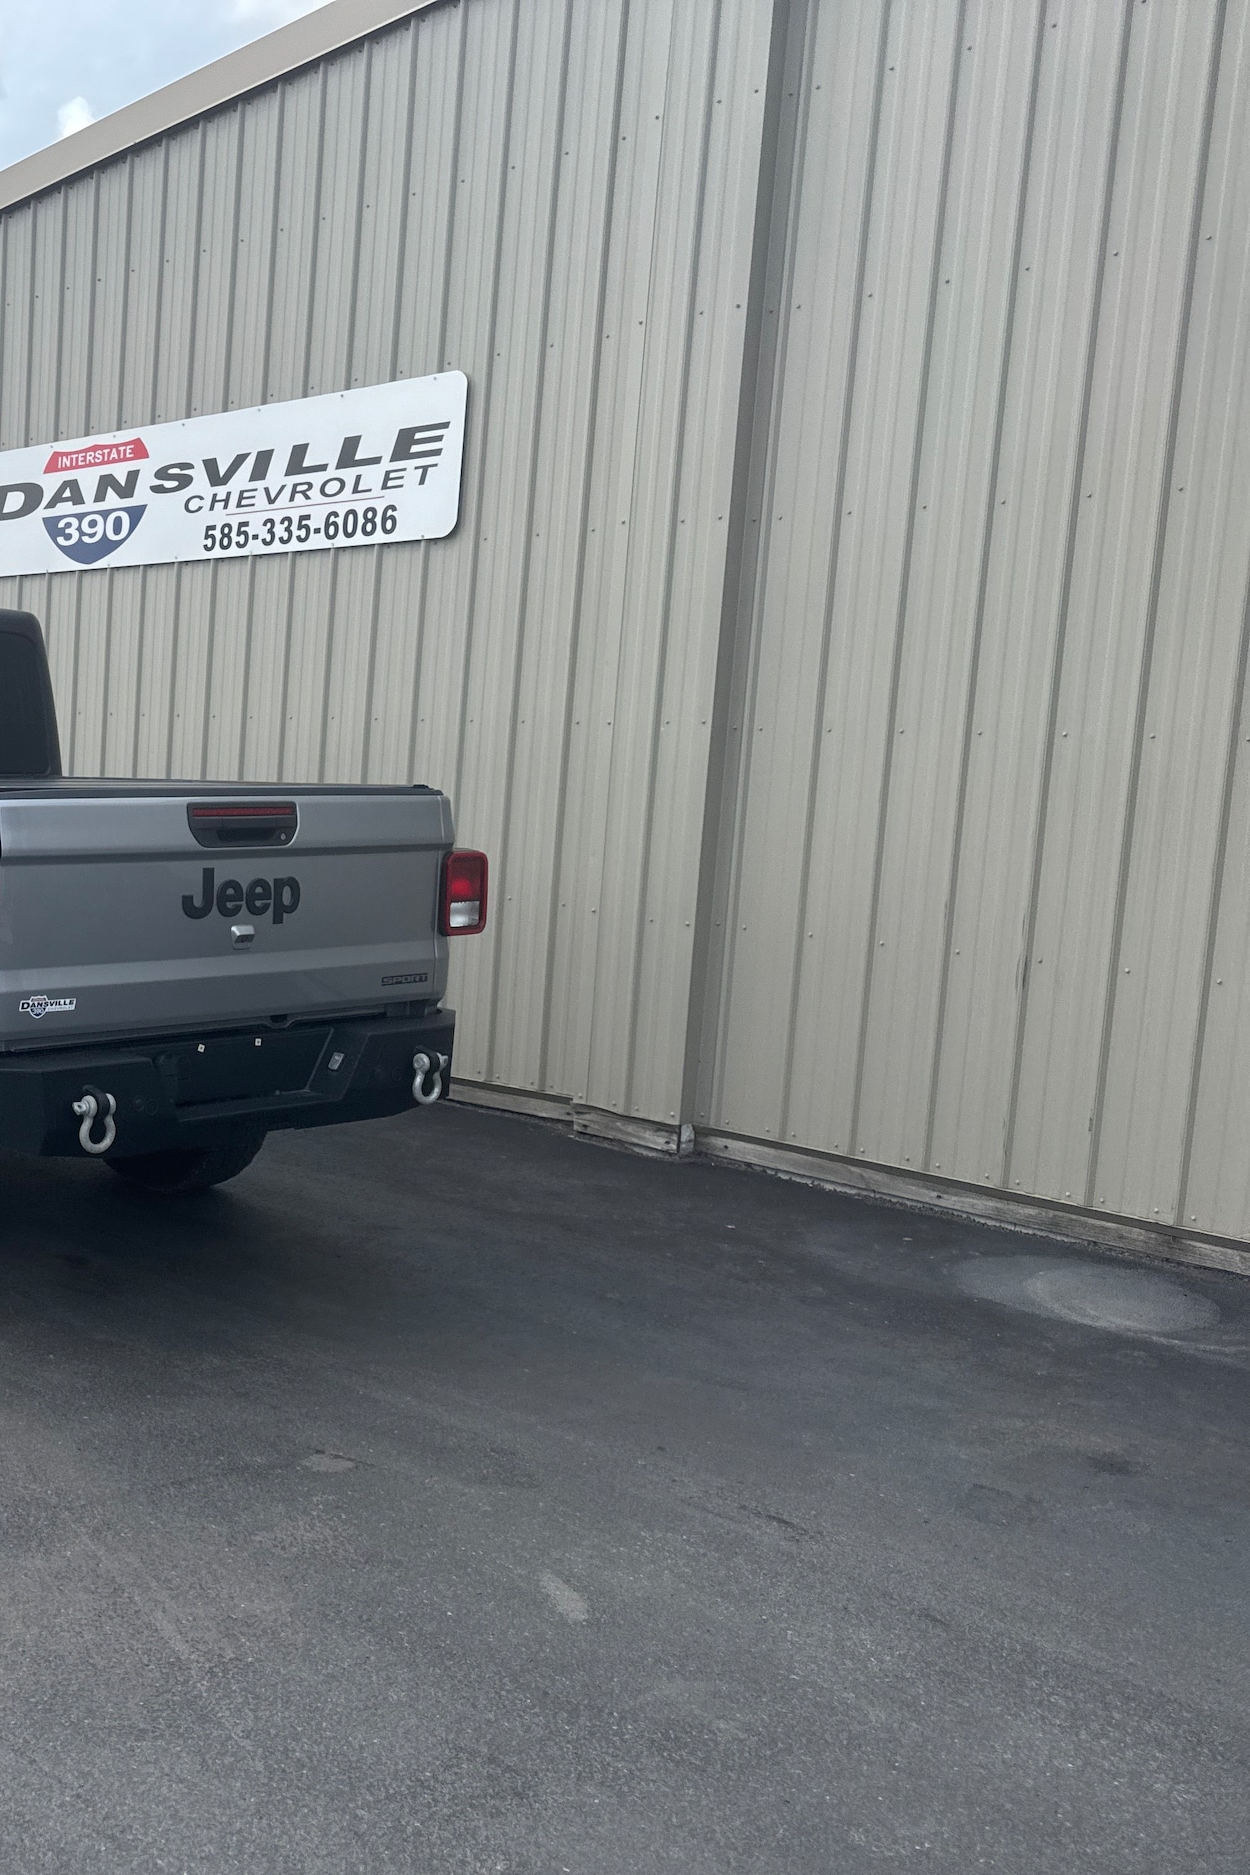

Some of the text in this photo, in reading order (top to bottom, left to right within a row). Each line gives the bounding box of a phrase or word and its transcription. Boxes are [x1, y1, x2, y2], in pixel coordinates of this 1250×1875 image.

[57, 445, 134, 468] INTERSTATE
[183, 463, 438, 514] CHEVROLET
[56, 510, 131, 546] 390
[203, 504, 398, 552] 585-335-6086
[181, 867, 301, 924] Jeep
[381, 973, 428, 986] SPORT
[20, 999, 75, 1010] DANSVILLE
